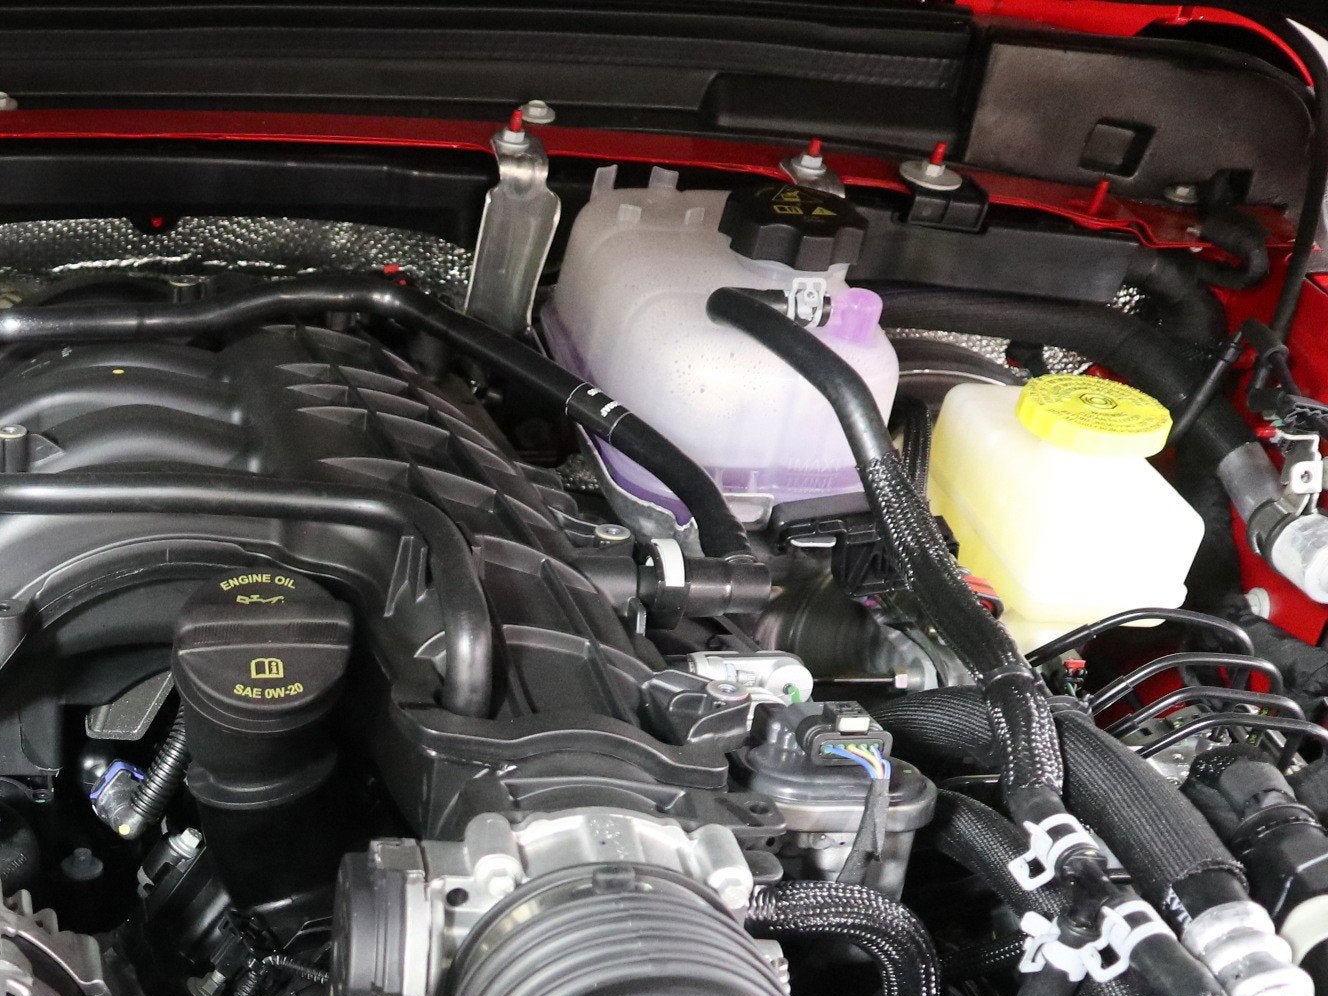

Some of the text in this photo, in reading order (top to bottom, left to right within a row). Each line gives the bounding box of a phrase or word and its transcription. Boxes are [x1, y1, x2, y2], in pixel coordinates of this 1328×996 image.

[220, 574, 296, 591] ENGINE OIL
[233, 682, 303, 699] SAE 0W-20
